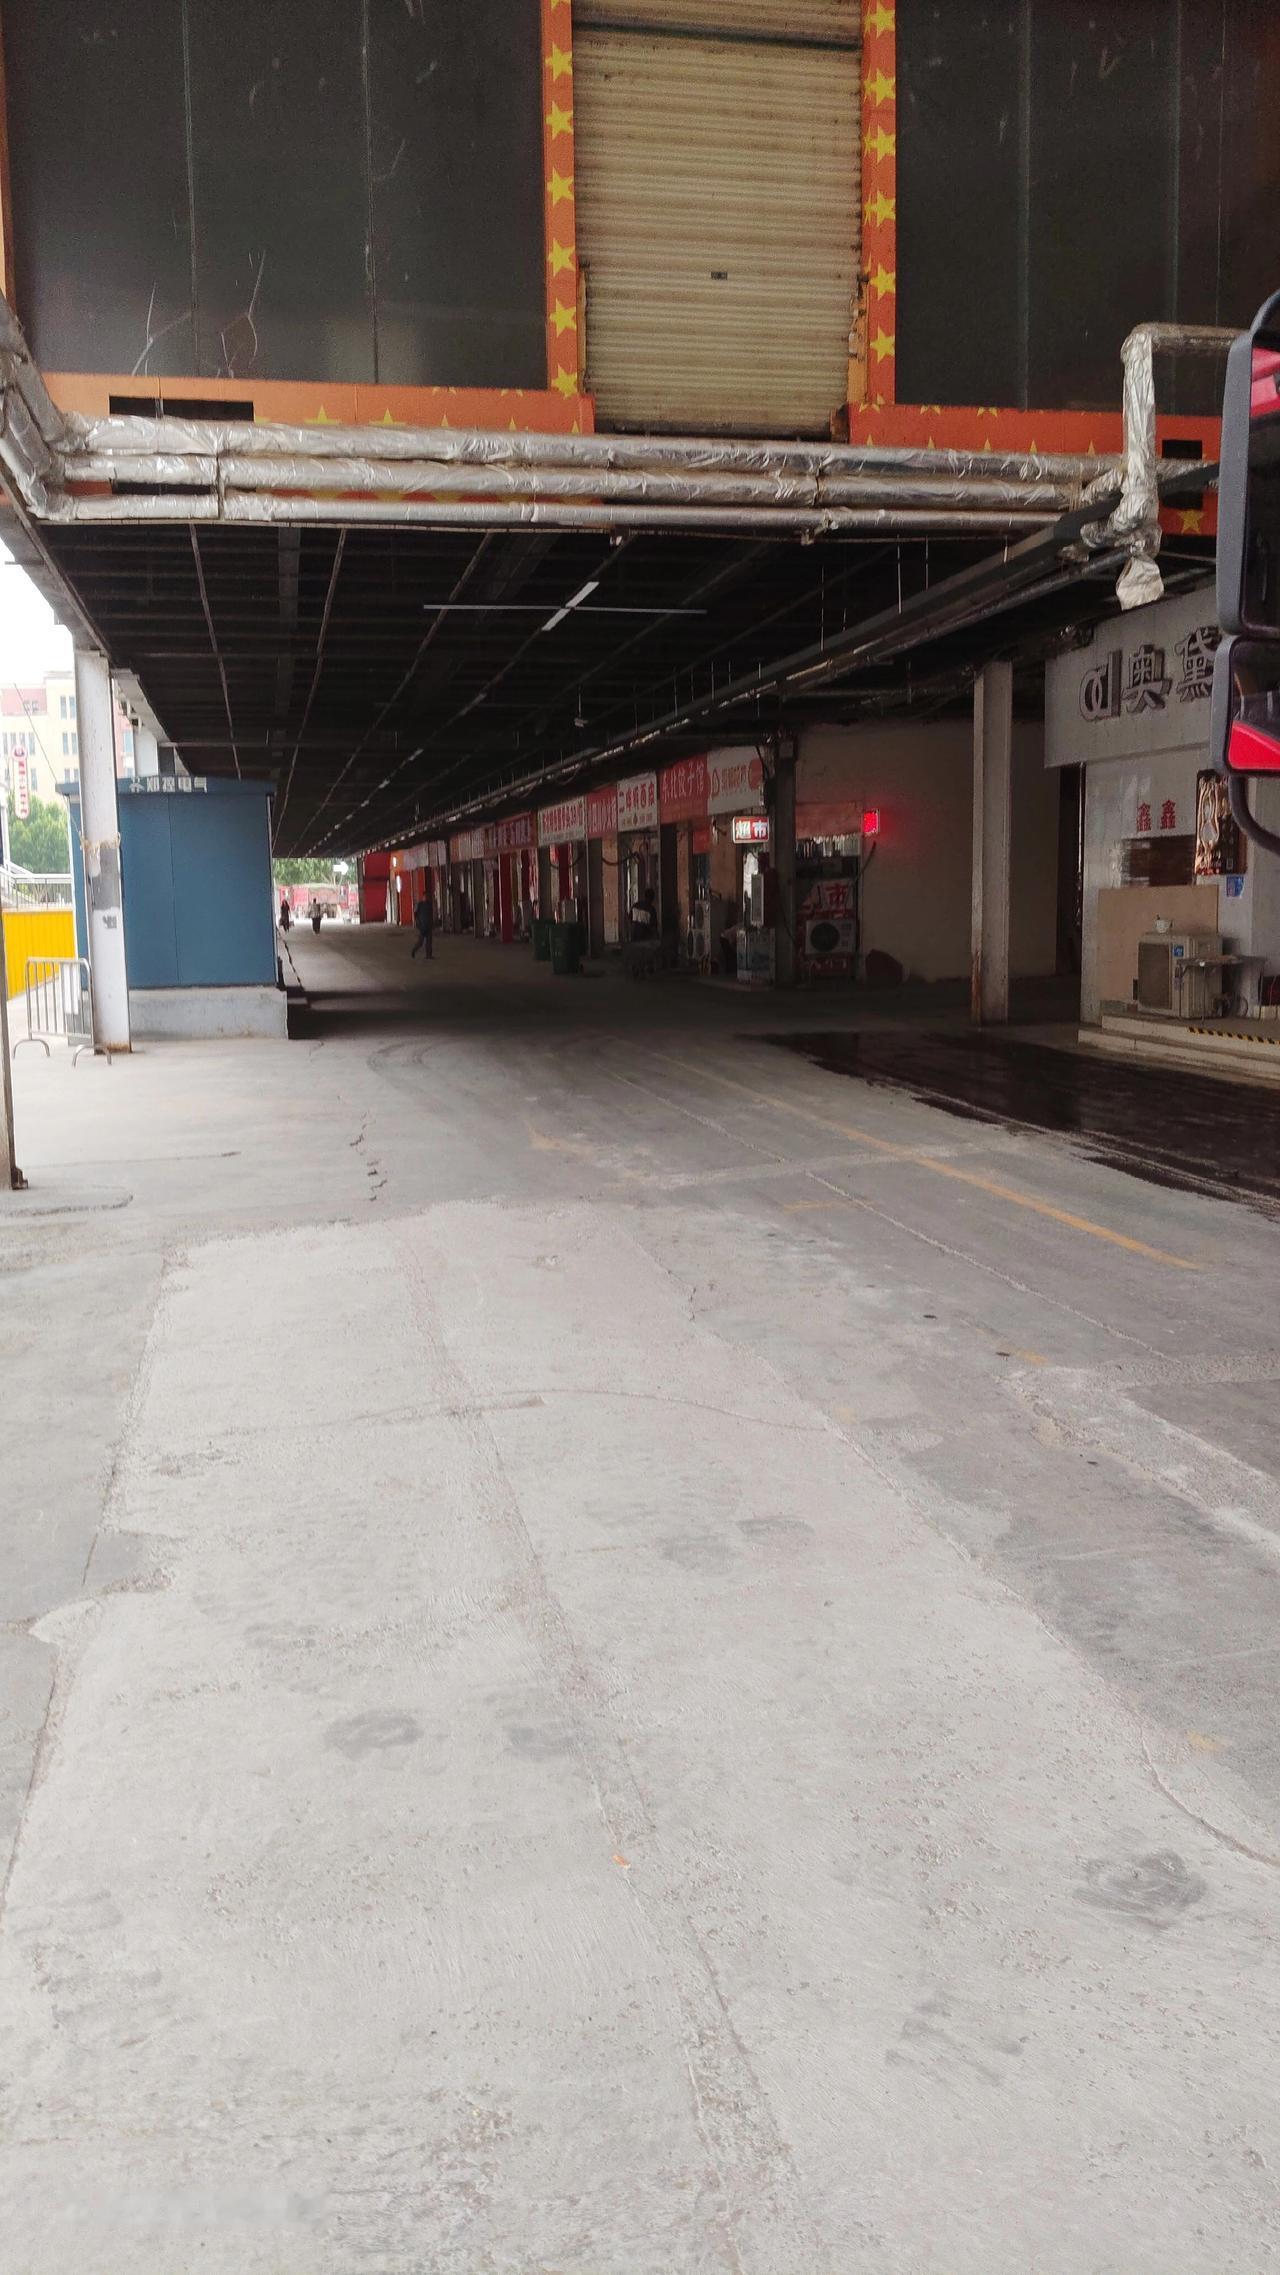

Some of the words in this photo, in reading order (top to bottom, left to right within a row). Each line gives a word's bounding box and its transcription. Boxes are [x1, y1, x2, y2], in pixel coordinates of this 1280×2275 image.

[662, 761, 704, 803] 东北饺子馆
[736, 820, 768, 840] 超市
[1137, 799, 1176, 832] 鑫鑫
